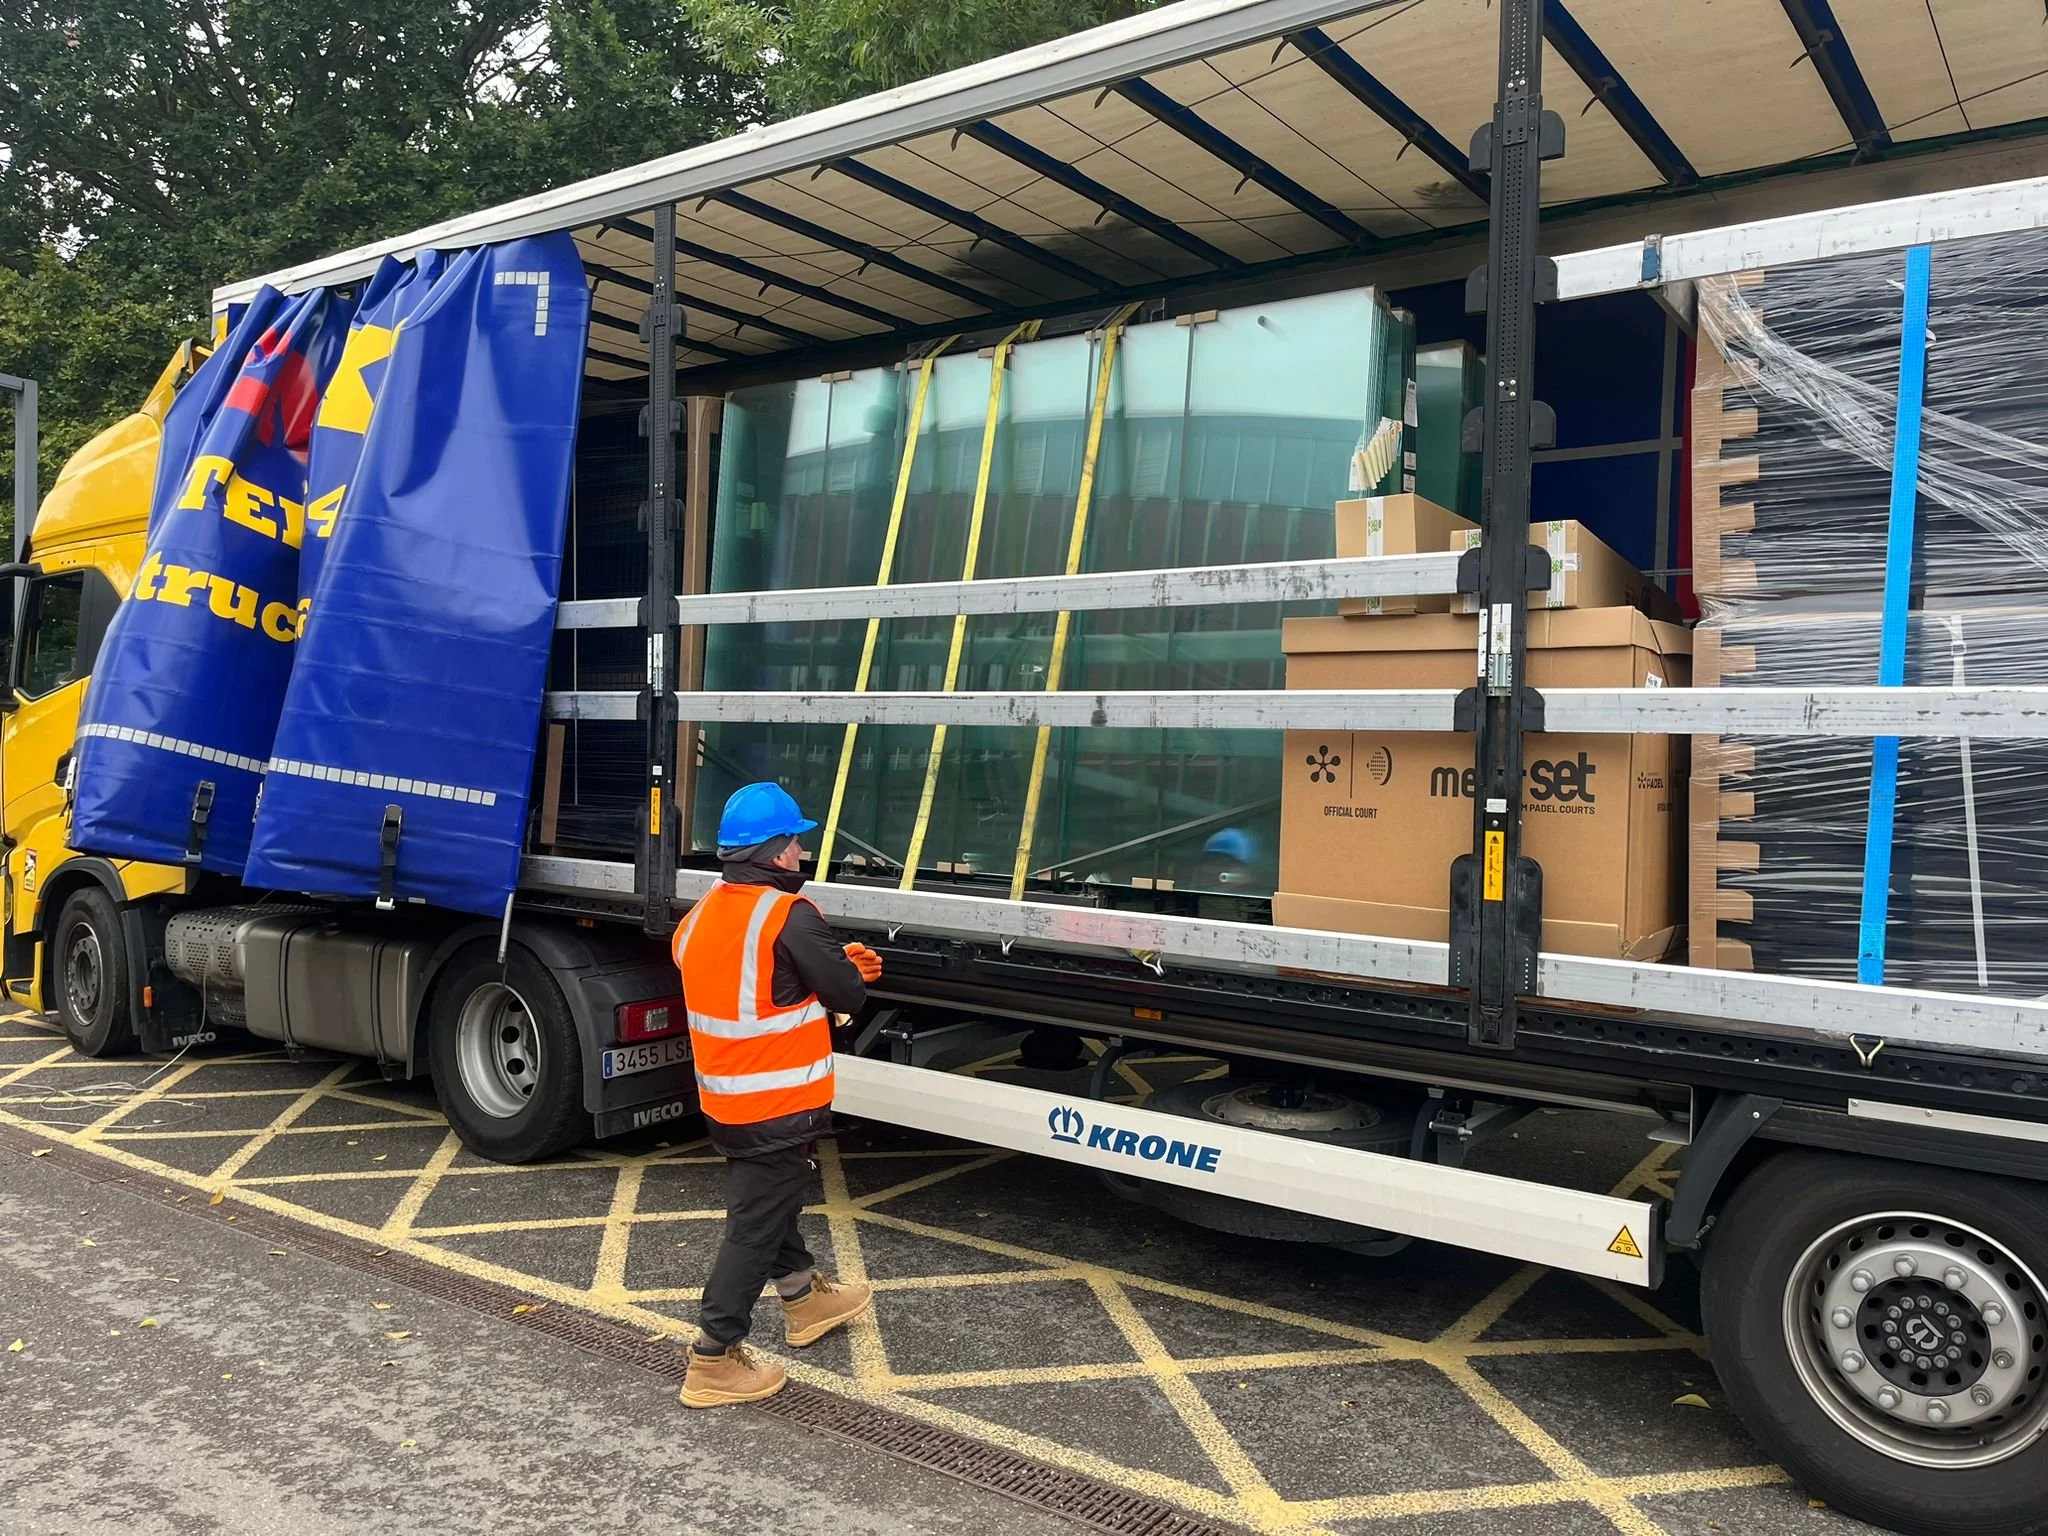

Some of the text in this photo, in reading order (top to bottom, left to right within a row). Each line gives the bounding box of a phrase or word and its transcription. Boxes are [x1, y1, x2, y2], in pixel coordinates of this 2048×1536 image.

[1324, 806, 1378, 819] OFFICIAL COURT
[1530, 804, 1557, 813] PADEL
[1560, 804, 1595, 815] COURTS
[172, 1031, 217, 1047] IVECO
[616, 1046, 659, 1072] 3455
[633, 1101, 684, 1128] IVECO
[1087, 1124, 1222, 1174] KRONE
